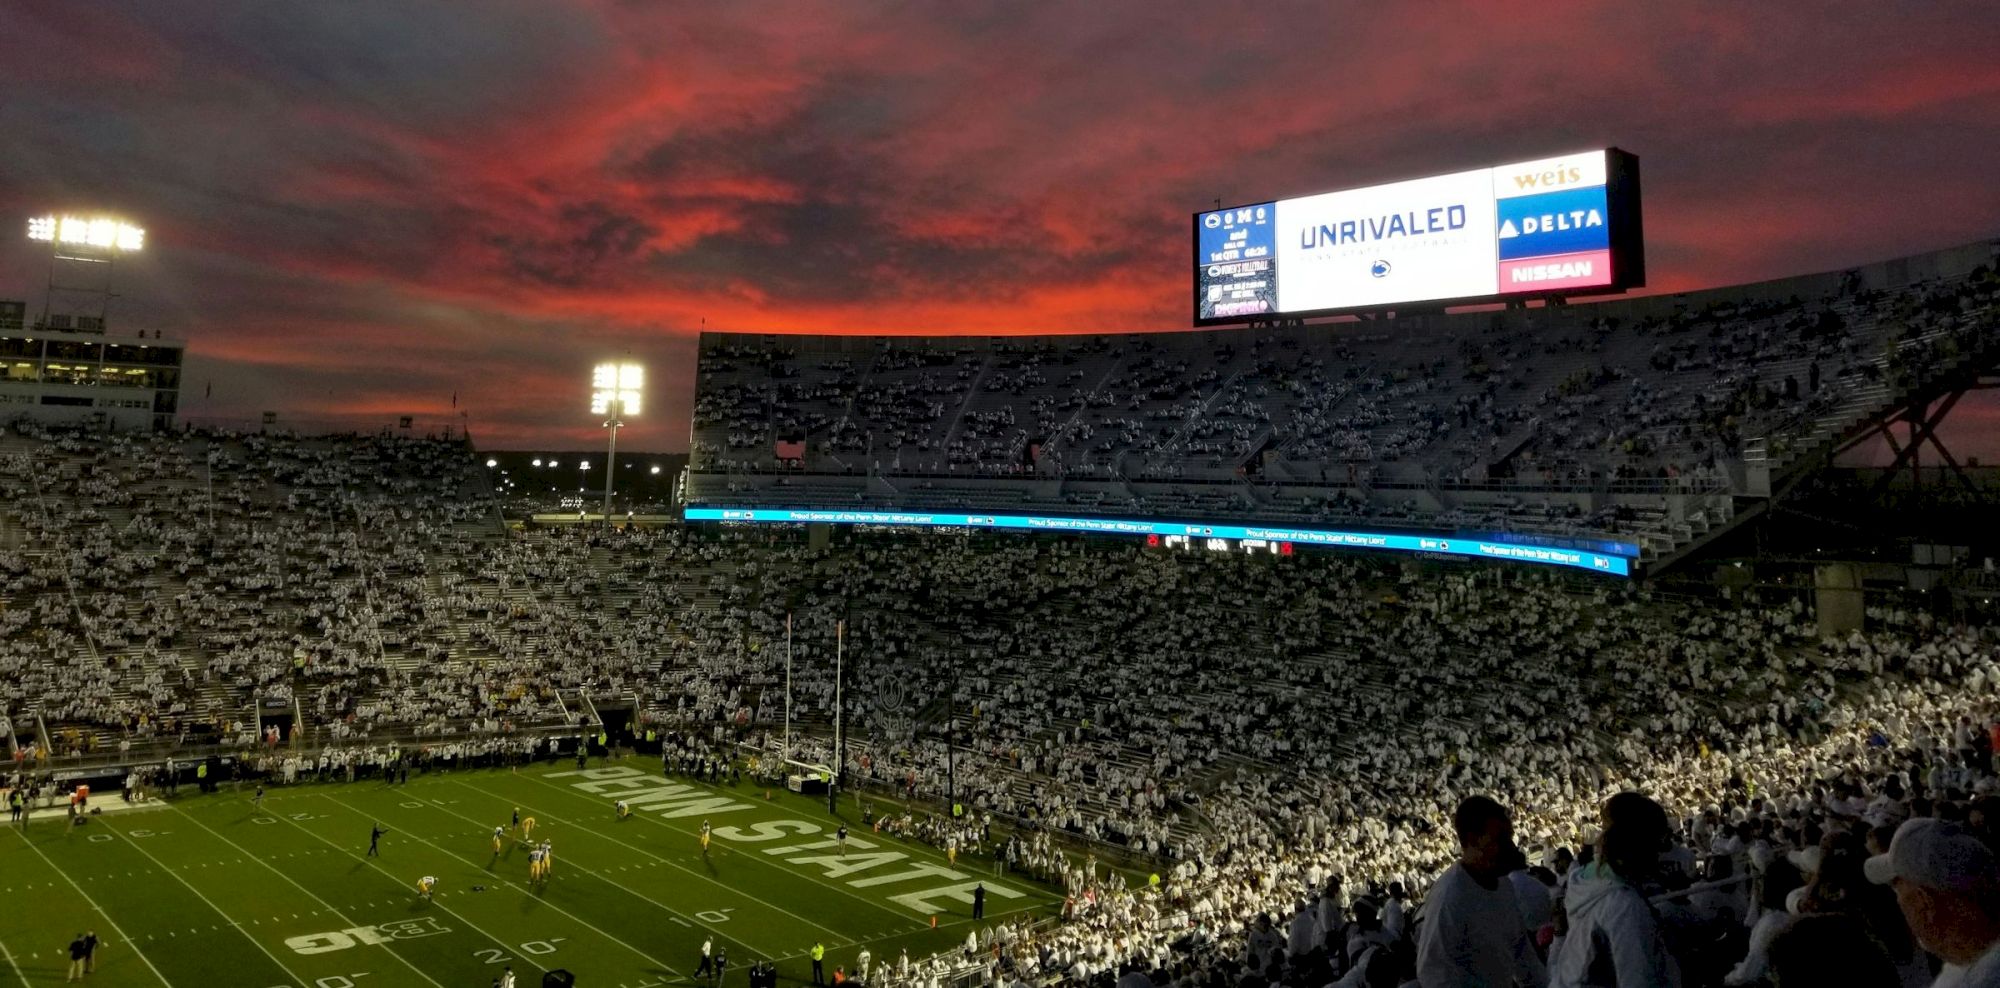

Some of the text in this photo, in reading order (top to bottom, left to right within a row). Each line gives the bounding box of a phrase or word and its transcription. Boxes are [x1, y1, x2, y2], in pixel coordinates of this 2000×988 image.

[1513, 164, 1581, 190] weis
[1301, 204, 1466, 250] UNRIVALED
[1522, 208, 1602, 235] DELTA
[1511, 260, 1593, 283] NISSAN
[811, 512, 834, 521] Sponsor
[1028, 518, 1045, 526] Proud
[1047, 519, 1069, 528] Sponsor
[1246, 529, 1264, 538] Proud
[1265, 530, 1288, 540] Sponsor
[1309, 533, 1326, 541] Penn
[542, 764, 1028, 915] PENN STATE
